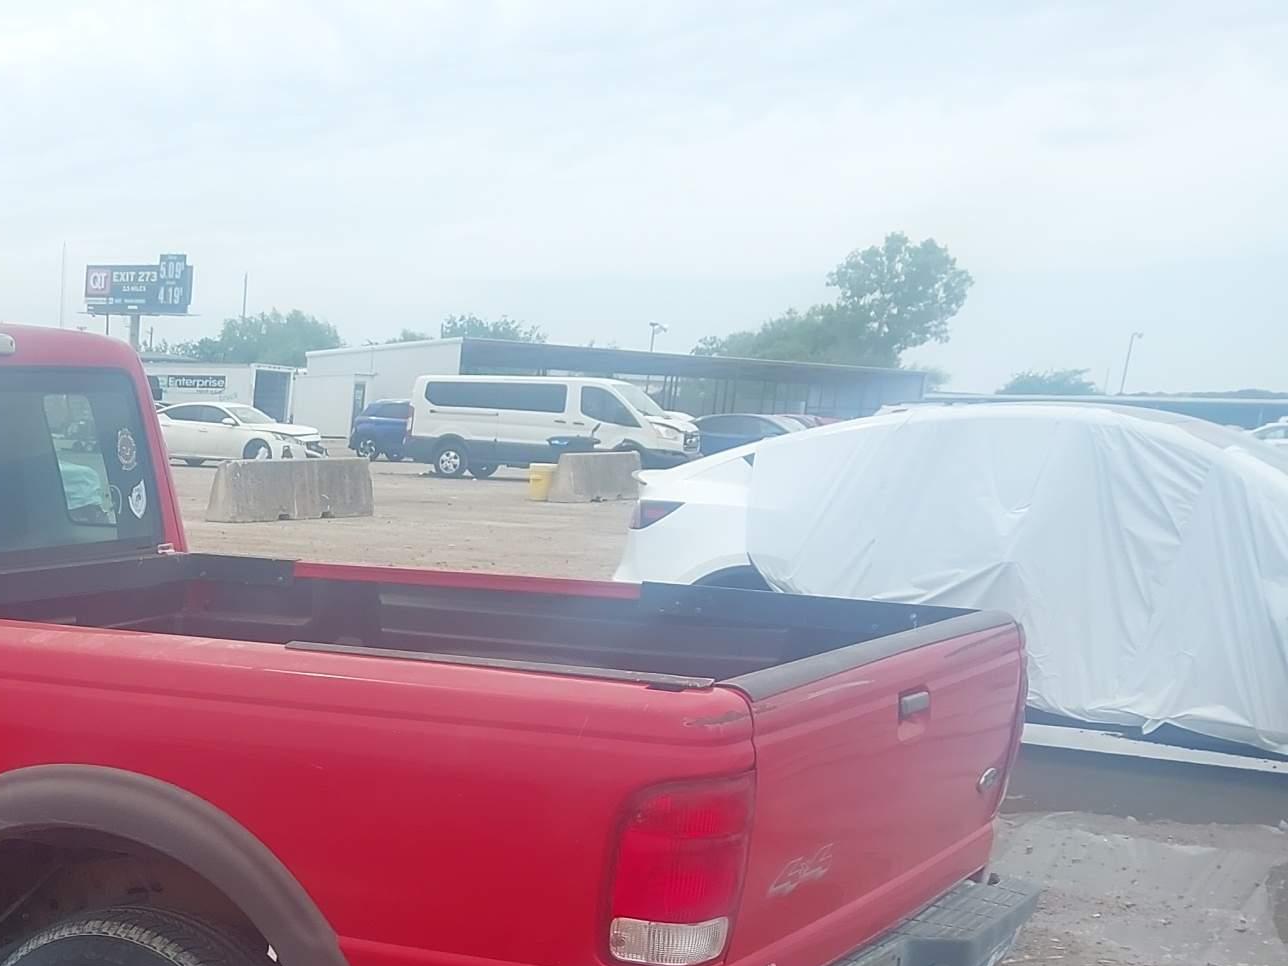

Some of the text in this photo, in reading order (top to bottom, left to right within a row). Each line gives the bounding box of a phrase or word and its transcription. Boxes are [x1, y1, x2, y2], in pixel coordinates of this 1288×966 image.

[90, 272, 107, 289] QT
[113, 271, 158, 282] EXIT 273
[168, 376, 225, 388] Enterprise
